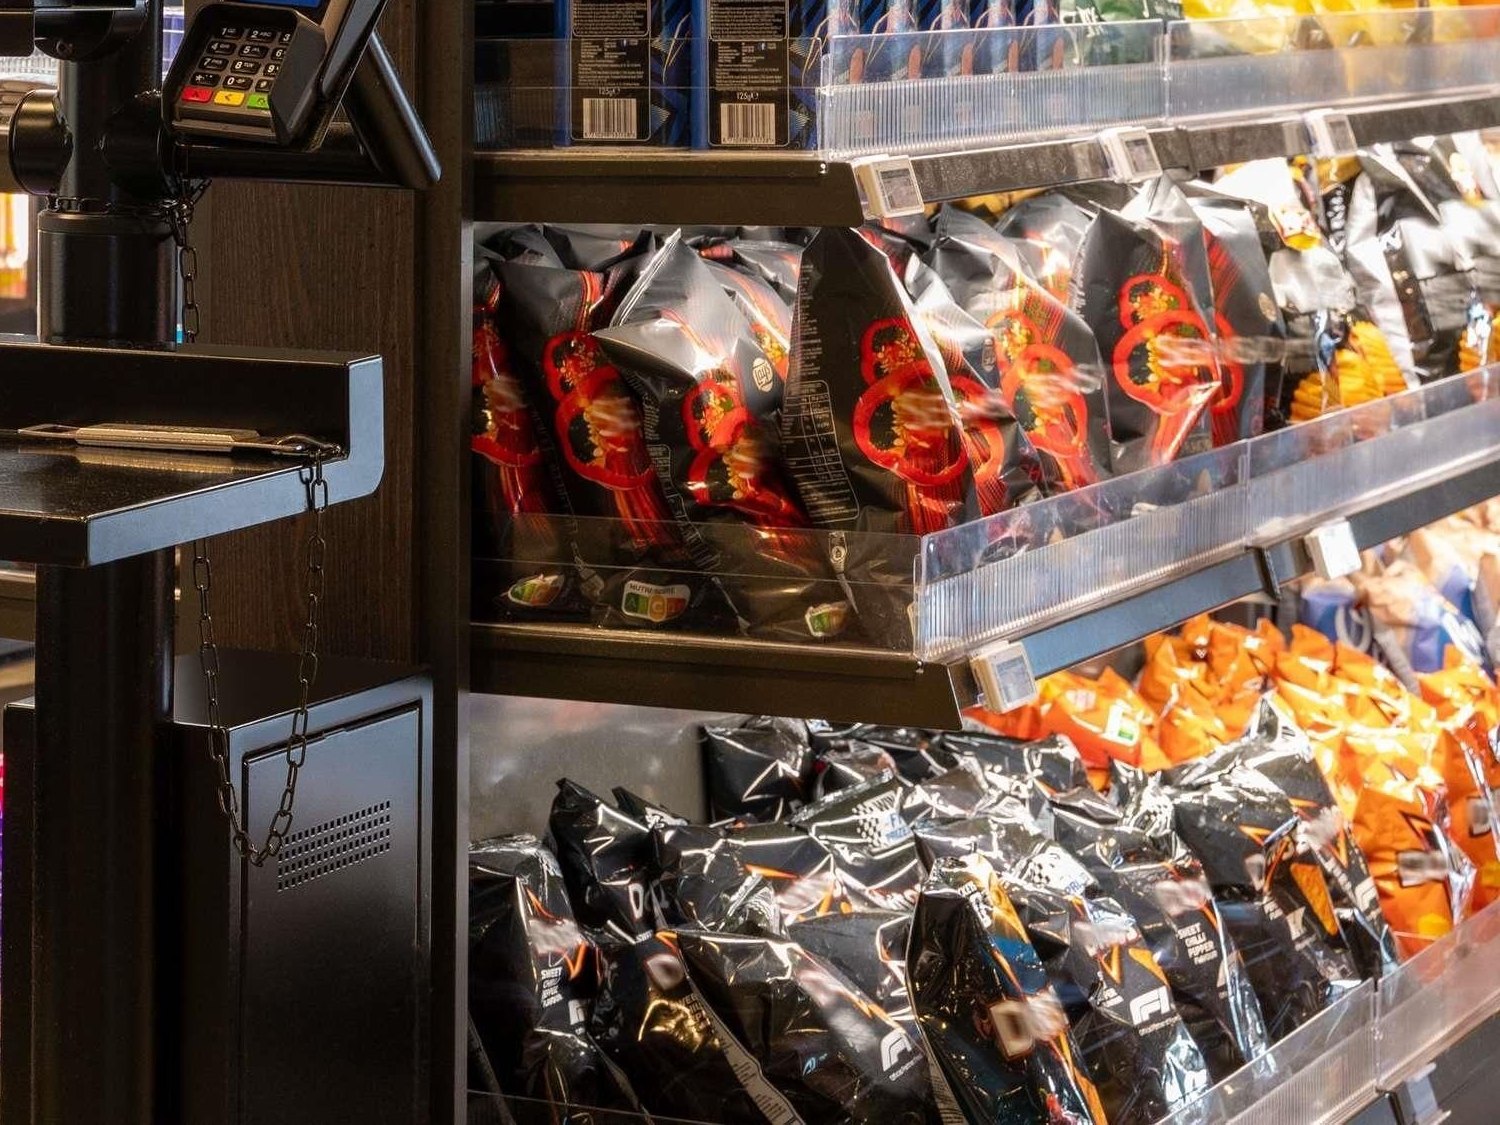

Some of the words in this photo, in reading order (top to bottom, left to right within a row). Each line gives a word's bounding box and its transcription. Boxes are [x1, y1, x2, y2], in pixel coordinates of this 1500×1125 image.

[252, 30, 259, 38] 2
[283, 33, 290, 41] 3
[211, 42, 218, 50] 4
[243, 46, 250, 54] 5
[275, 49, 282, 57] 6
[235, 61, 242, 69] 8
[267, 65, 275, 73] 9
[227, 77, 235, 85] 0
[1188, 940, 1215, 958] PEPPER
